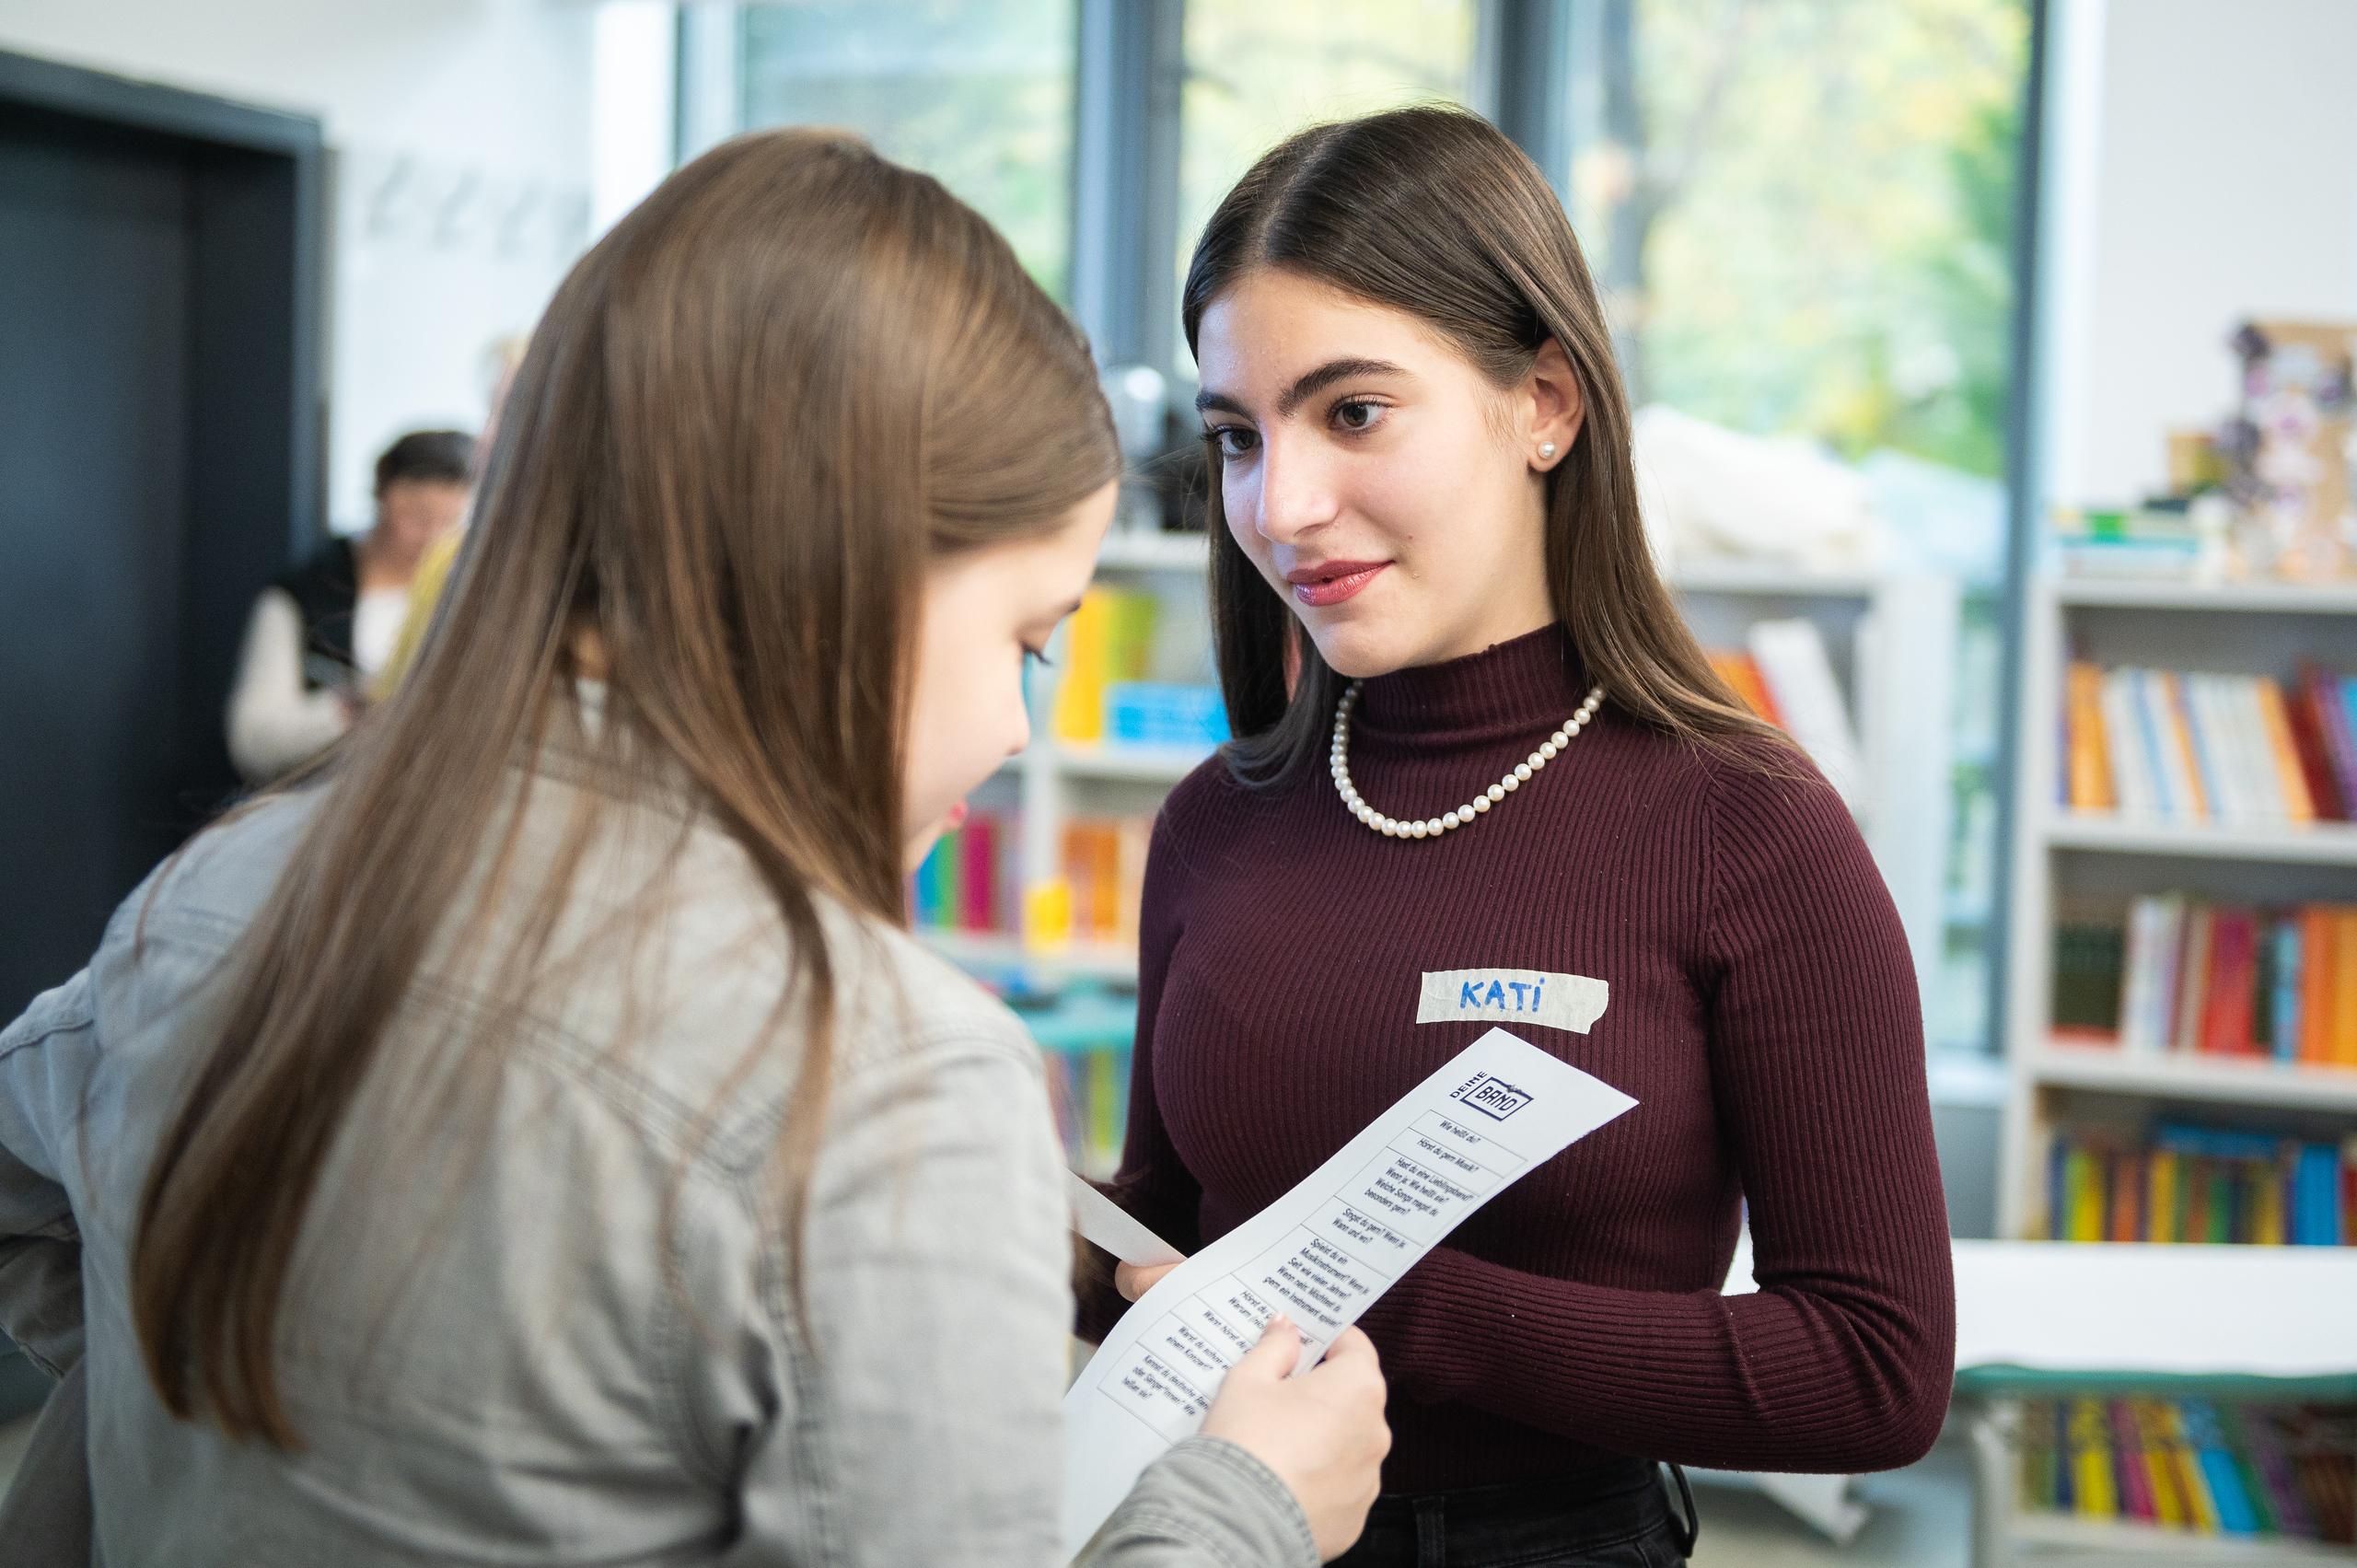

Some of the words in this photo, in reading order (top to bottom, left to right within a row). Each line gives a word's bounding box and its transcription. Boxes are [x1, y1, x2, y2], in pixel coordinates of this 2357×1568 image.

[1449, 1071, 1488, 1098] DEINE
[1475, 1086, 1518, 1111] BAND
[1417, 1138, 1436, 1151] Hörst
[1395, 1157, 1411, 1169] Hast
[1416, 1170, 1431, 1180] eine
[1288, 1257, 1303, 1270] Seit
